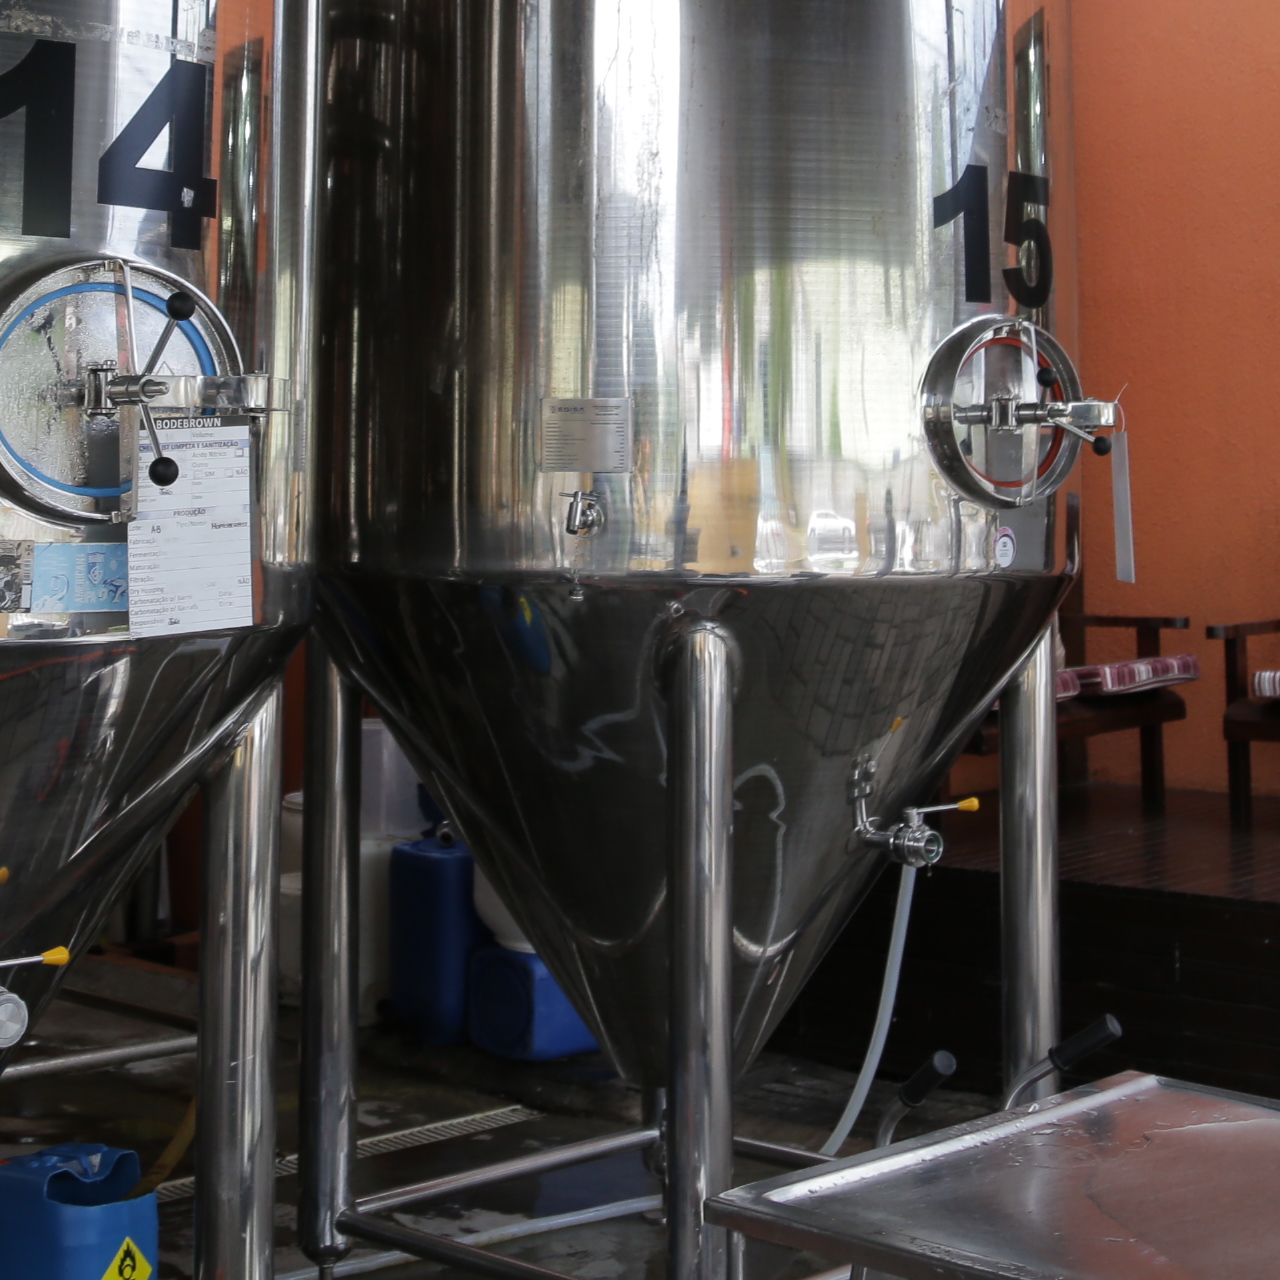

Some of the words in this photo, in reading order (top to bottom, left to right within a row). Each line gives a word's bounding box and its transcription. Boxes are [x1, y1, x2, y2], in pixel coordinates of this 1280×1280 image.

[933, 164, 1053, 309] 15
[156, 418, 221, 429] BODEBROWN
[171, 442, 196, 450] LIMPEZA
[201, 440, 239, 448] SANITIZAÇÃO
[235, 468, 248, 476] NÃO
[173, 508, 206, 517] PRODUÇÃO
[237, 577, 250, 585] NÃO
[130, 588, 140, 596] Dry
[130, 597, 168, 606] Carbonatação
[130, 607, 169, 616] Carbonatação
